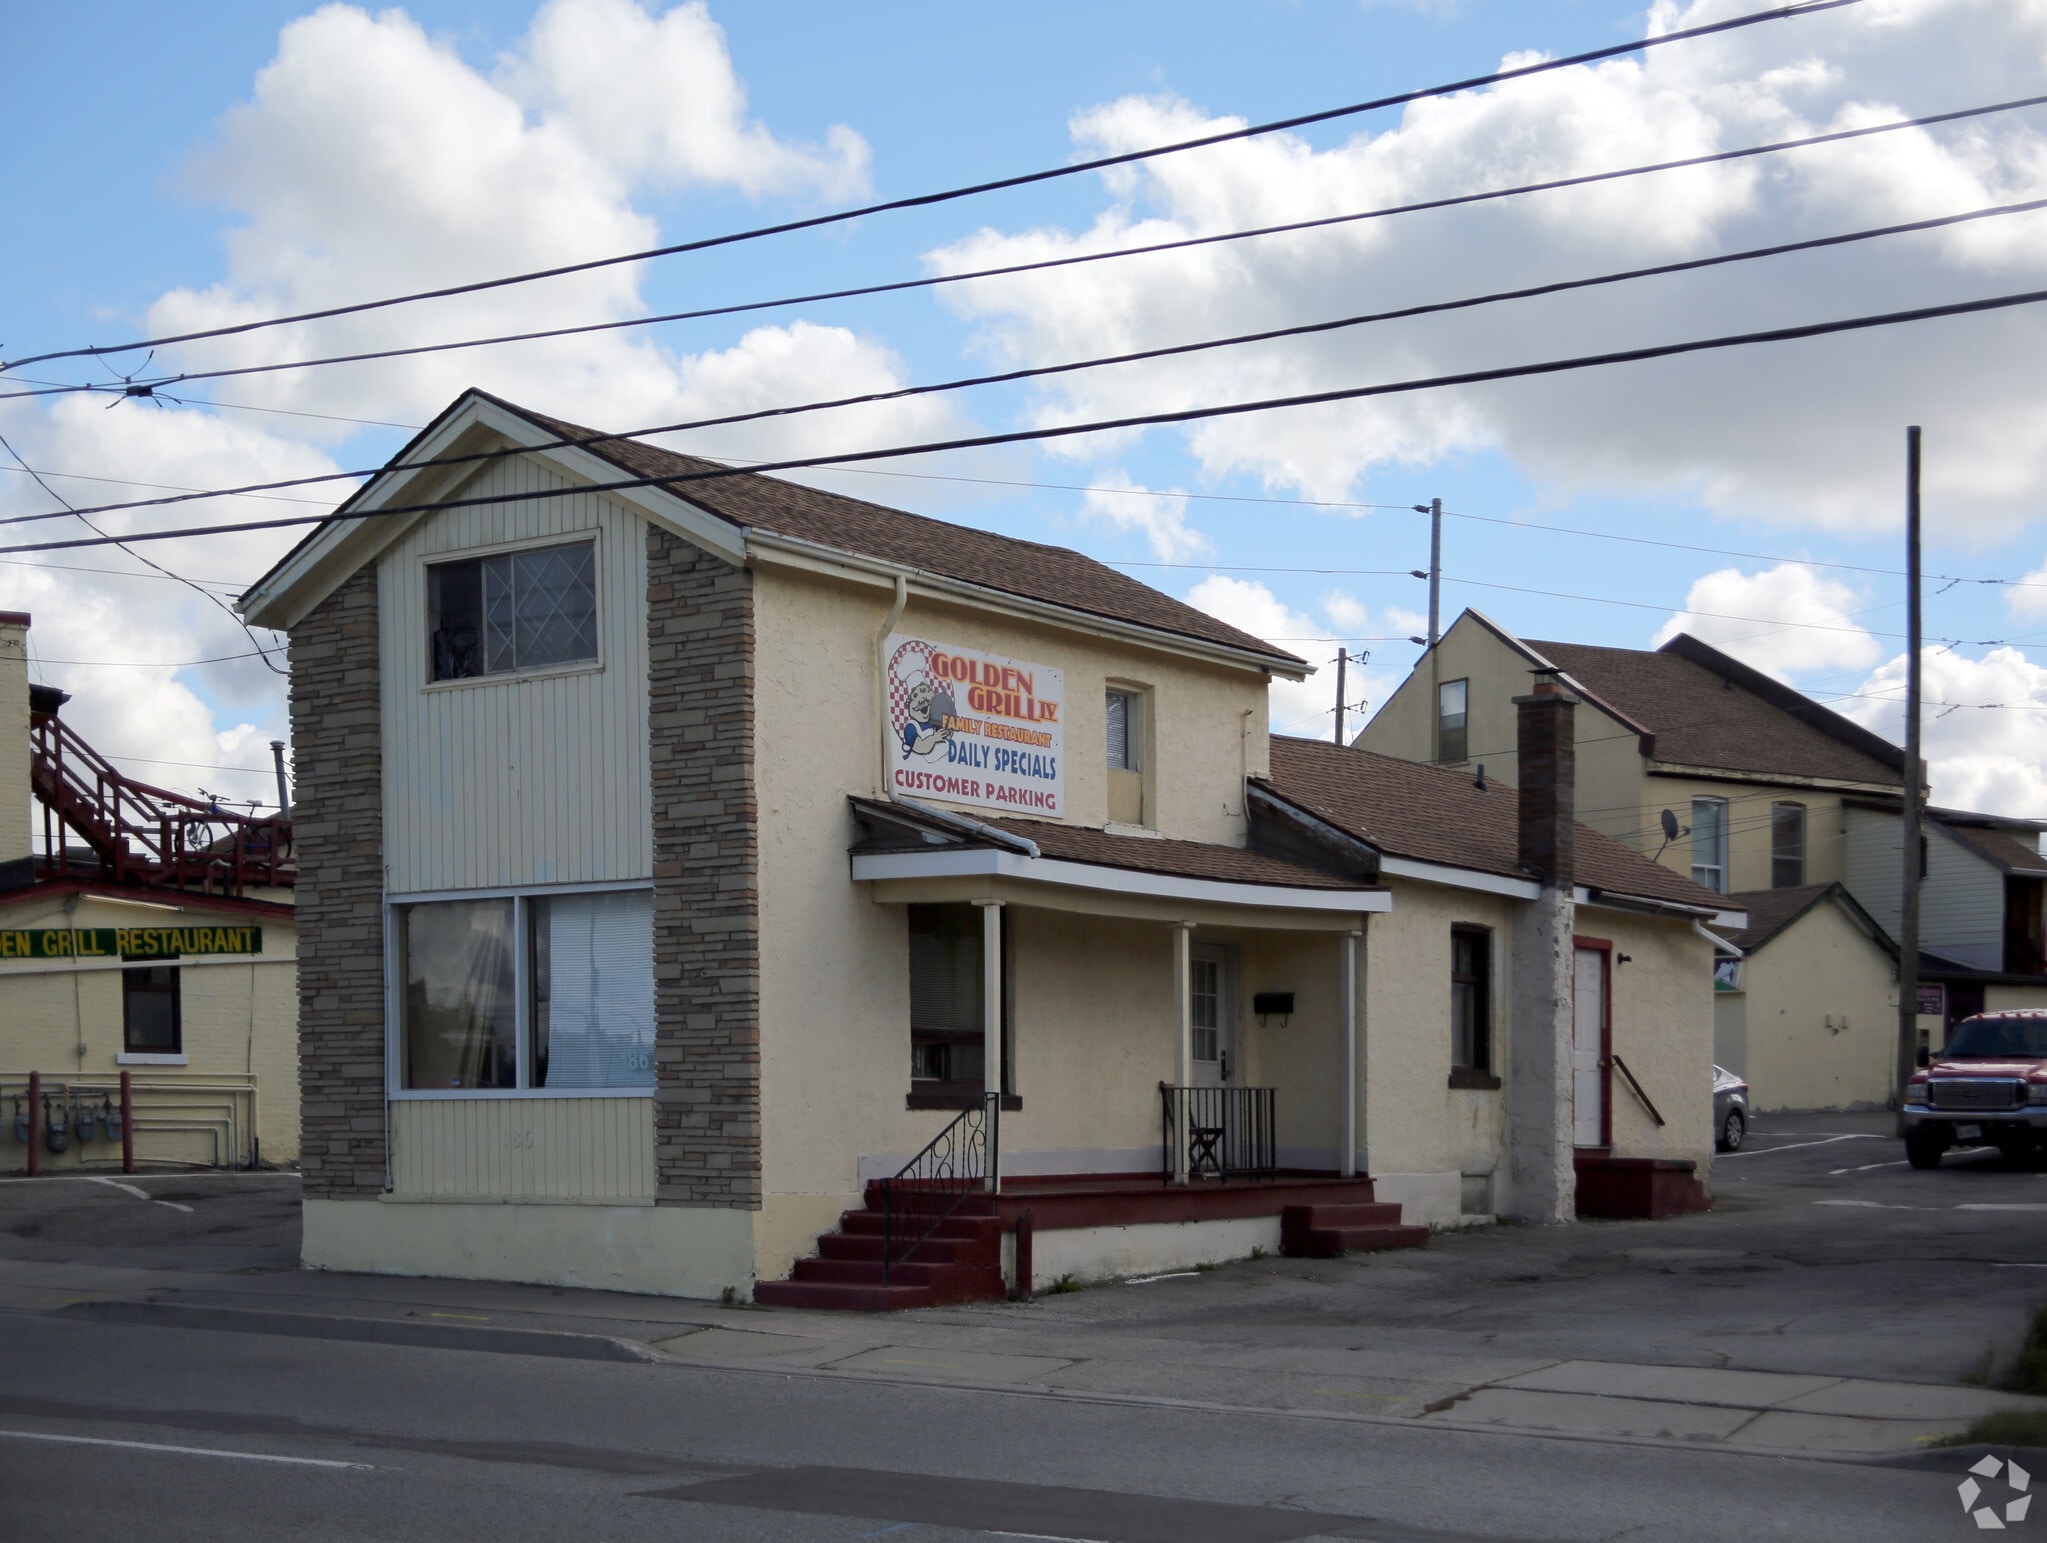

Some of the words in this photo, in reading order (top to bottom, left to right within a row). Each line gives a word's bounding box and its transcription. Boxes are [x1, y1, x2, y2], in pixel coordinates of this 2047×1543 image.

[930, 652, 1034, 696] GOLDEN
[967, 685, 1042, 723] GRILL
[941, 713, 983, 736] FAMILY
[983, 720, 1053, 748] RESTAURANT
[948, 739, 990, 769] DAILY
[994, 747, 1056, 780] SPECIALS
[895, 769, 980, 798] CUSTOMER
[985, 783, 1056, 810] PARKING
[0, 931, 31, 957] EN
[116, 927, 255, 954] RESTAURANT
